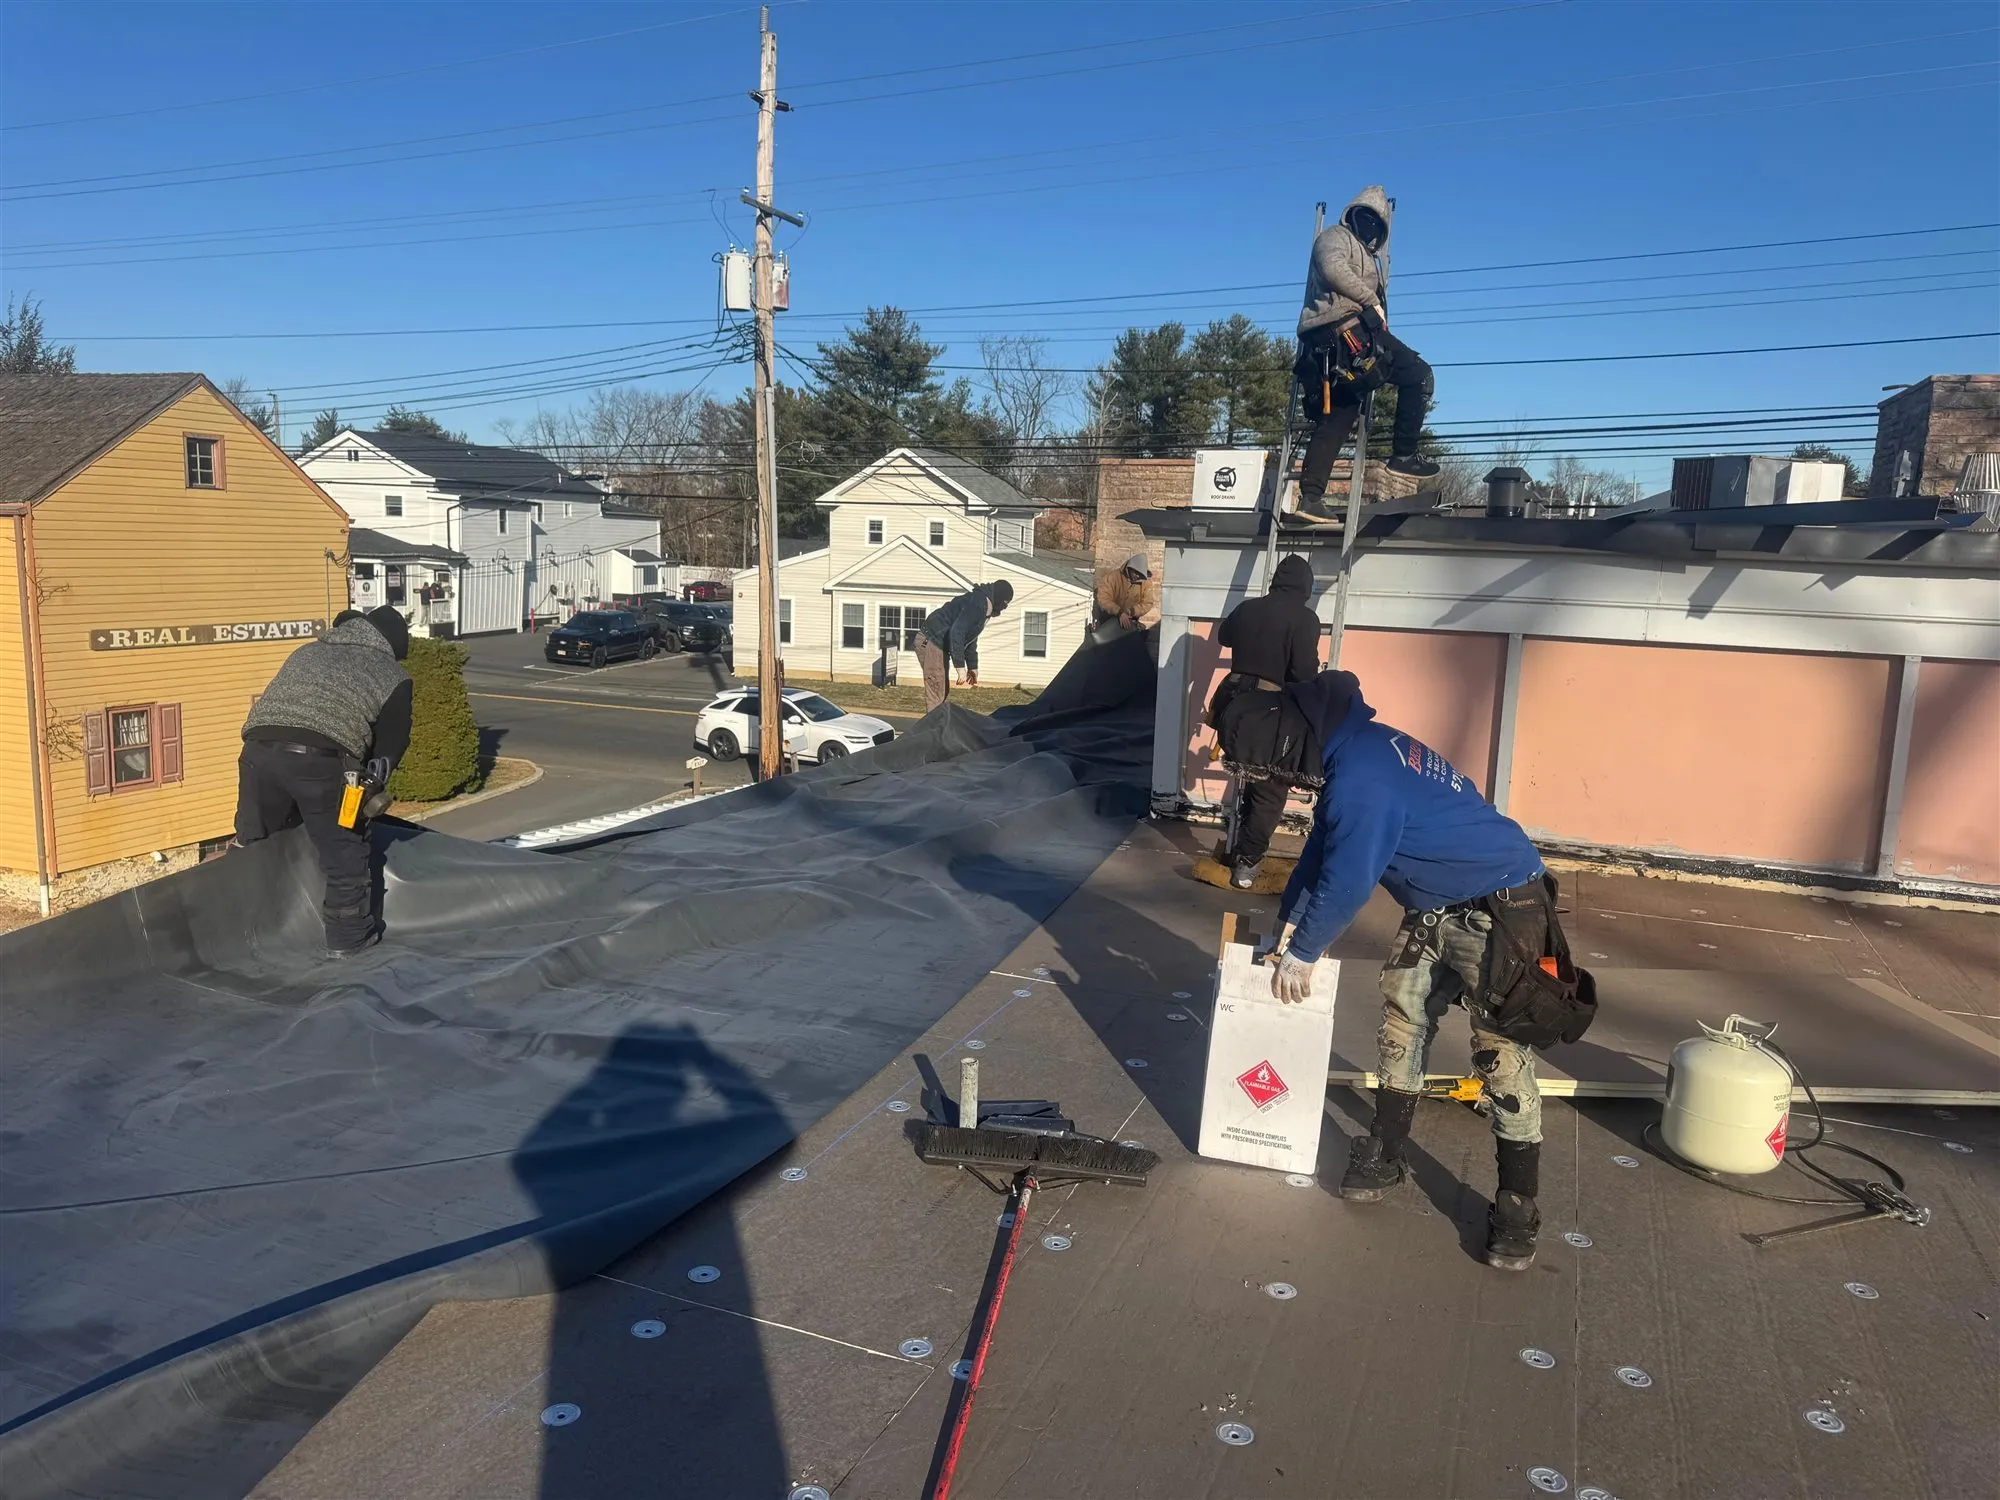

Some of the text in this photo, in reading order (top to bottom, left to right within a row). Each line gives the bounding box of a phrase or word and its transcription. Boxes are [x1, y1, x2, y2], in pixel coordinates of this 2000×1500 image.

[110, 621, 313, 648] REAL ESTATE
[1220, 1003, 1235, 1013] WC
[1244, 1080, 1270, 1091] FLAMMABLE
[1226, 1126, 1287, 1142] INSIDE CONTAINER COMPLIES
[1232, 1134, 1258, 1145] PRESCRIBED
[1258, 1139, 1292, 1151] SPECIFICATIONS
